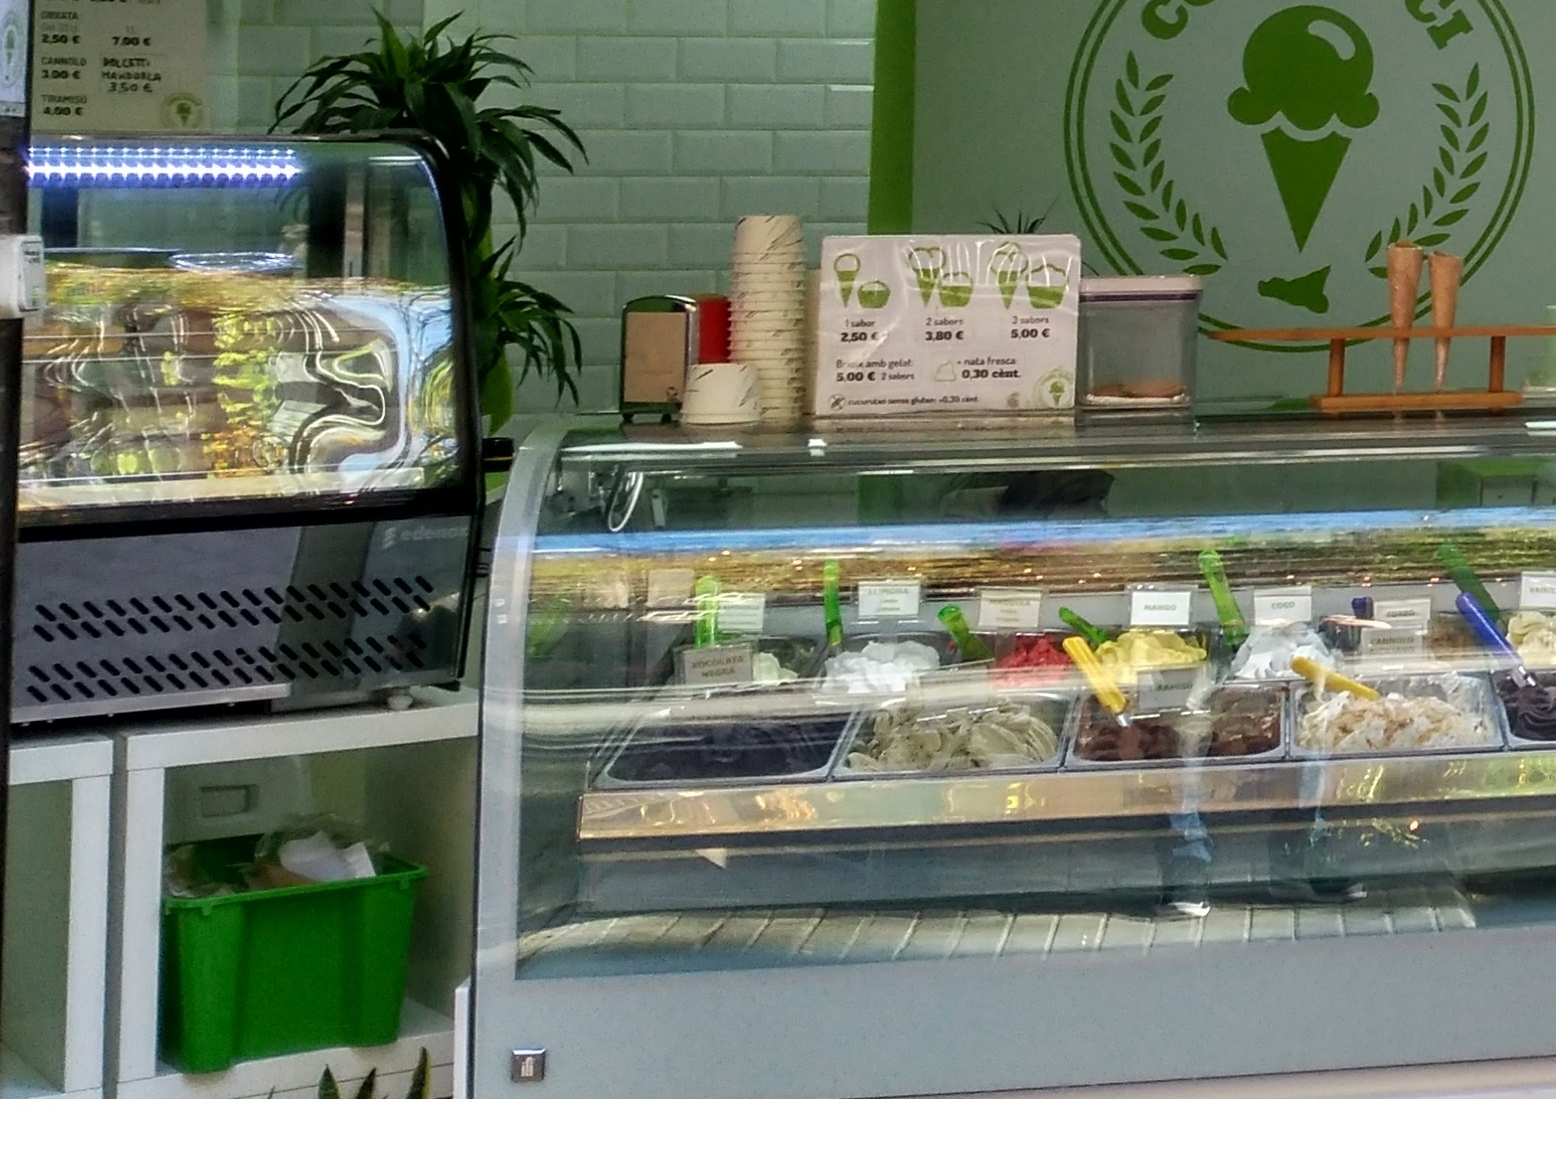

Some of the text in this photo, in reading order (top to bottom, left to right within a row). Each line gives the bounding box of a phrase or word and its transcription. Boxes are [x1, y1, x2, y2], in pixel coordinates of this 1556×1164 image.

[72, 35, 81, 44] €
[142, 36, 152, 46] €
[72, 70, 81, 80] €
[143, 83, 153, 93] €
[75, 106, 84, 116] €
[851, 318, 876, 328] sabor
[926, 317, 964, 326] 2 sabors
[1012, 315, 1049, 325] 3 sabors
[870, 332, 880, 342] €
[955, 331, 964, 341] €
[1041, 327, 1050, 338] €
[865, 359, 886, 368] amb
[964, 357, 985, 366] nata
[867, 371, 876, 382] €
[881, 372, 887, 381] 2
[888, 372, 915, 381] sabors
[1143, 603, 1177, 612] MANGO
[1271, 600, 1295, 610] COCO
